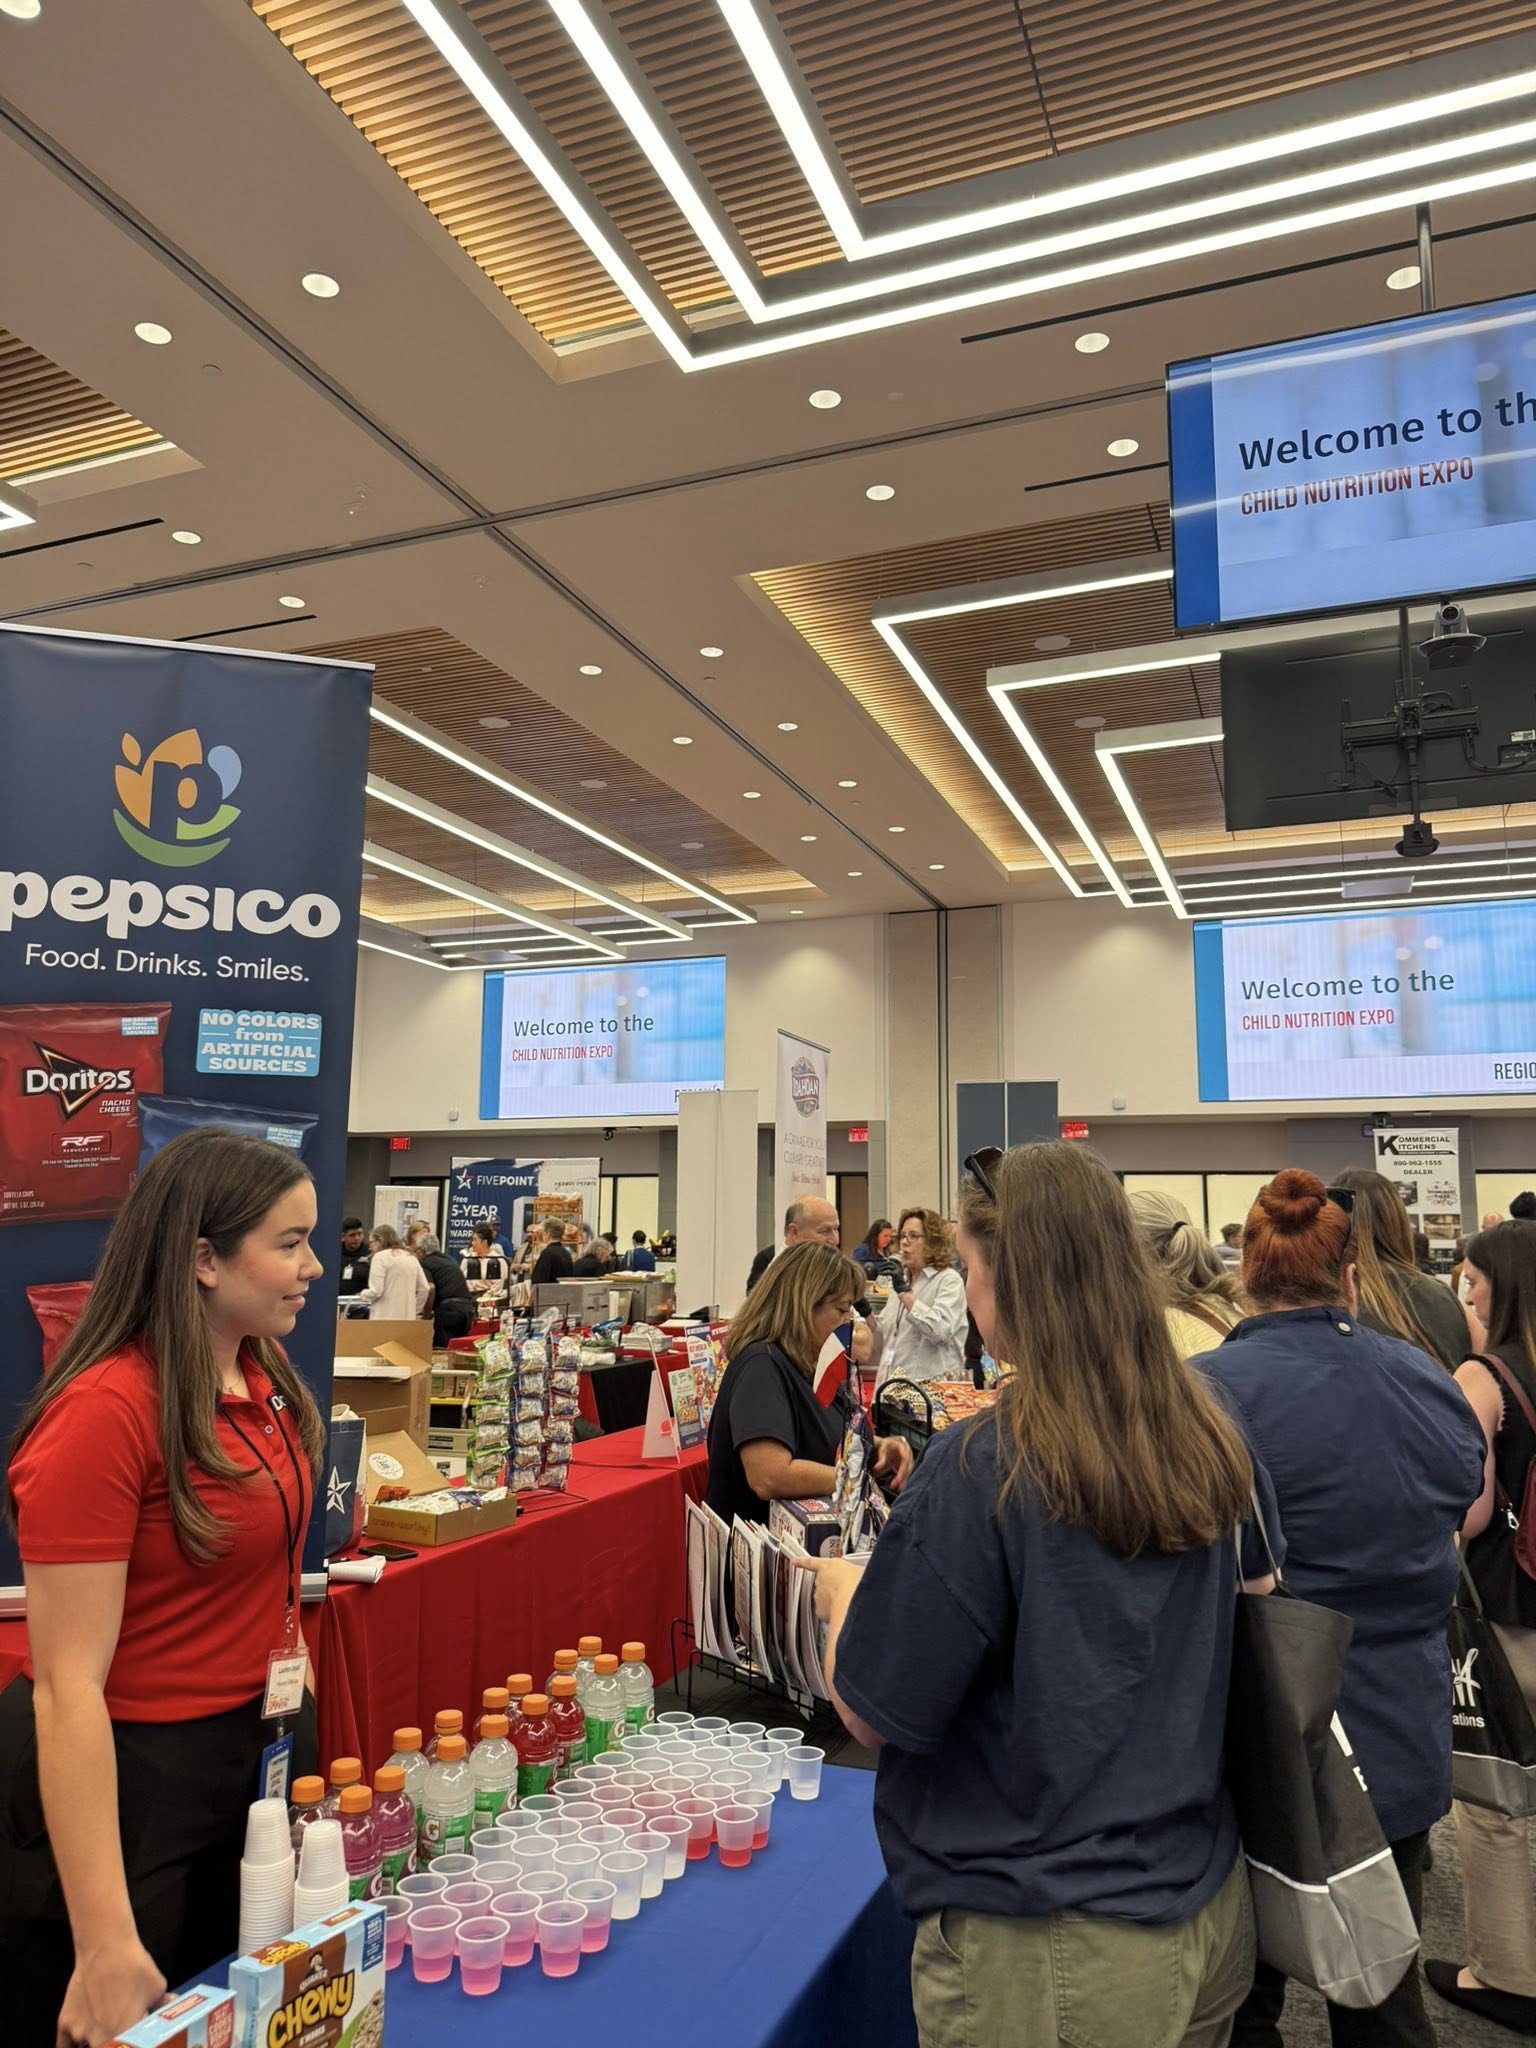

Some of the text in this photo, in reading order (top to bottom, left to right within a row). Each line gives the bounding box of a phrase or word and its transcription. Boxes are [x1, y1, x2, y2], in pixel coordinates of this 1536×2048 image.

[1239, 418, 1425, 470] Welcome
[1437, 408, 1482, 437] to
[1240, 456, 1474, 515] CHILD NUTRITION EXPO
[0, 871, 341, 939] pepsico
[25, 944, 310, 982] Food. Drinks. Smiles.
[1241, 969, 1455, 1000] Welcome to the
[202, 1012, 320, 1029] NO COLORS
[513, 1013, 655, 1037] Welcome to the
[1242, 1008, 1395, 1030] CHILD NUTRITION EXPO
[235, 1027, 285, 1042] from
[201, 1042, 317, 1059] ARTIFICIAL
[512, 1045, 613, 1061] CHILD NUTRITION EXPO
[208, 1057, 307, 1073] SOURCES
[26, 1068, 132, 1094] Doritos
[101, 1099, 131, 1107] NACHO
[476, 1175, 535, 1187] FIVEPOINT
[452, 1195, 469, 1204] Free
[451, 1205, 498, 1217] 5-YEAR
[450, 1219, 474, 1227] TOTAL
